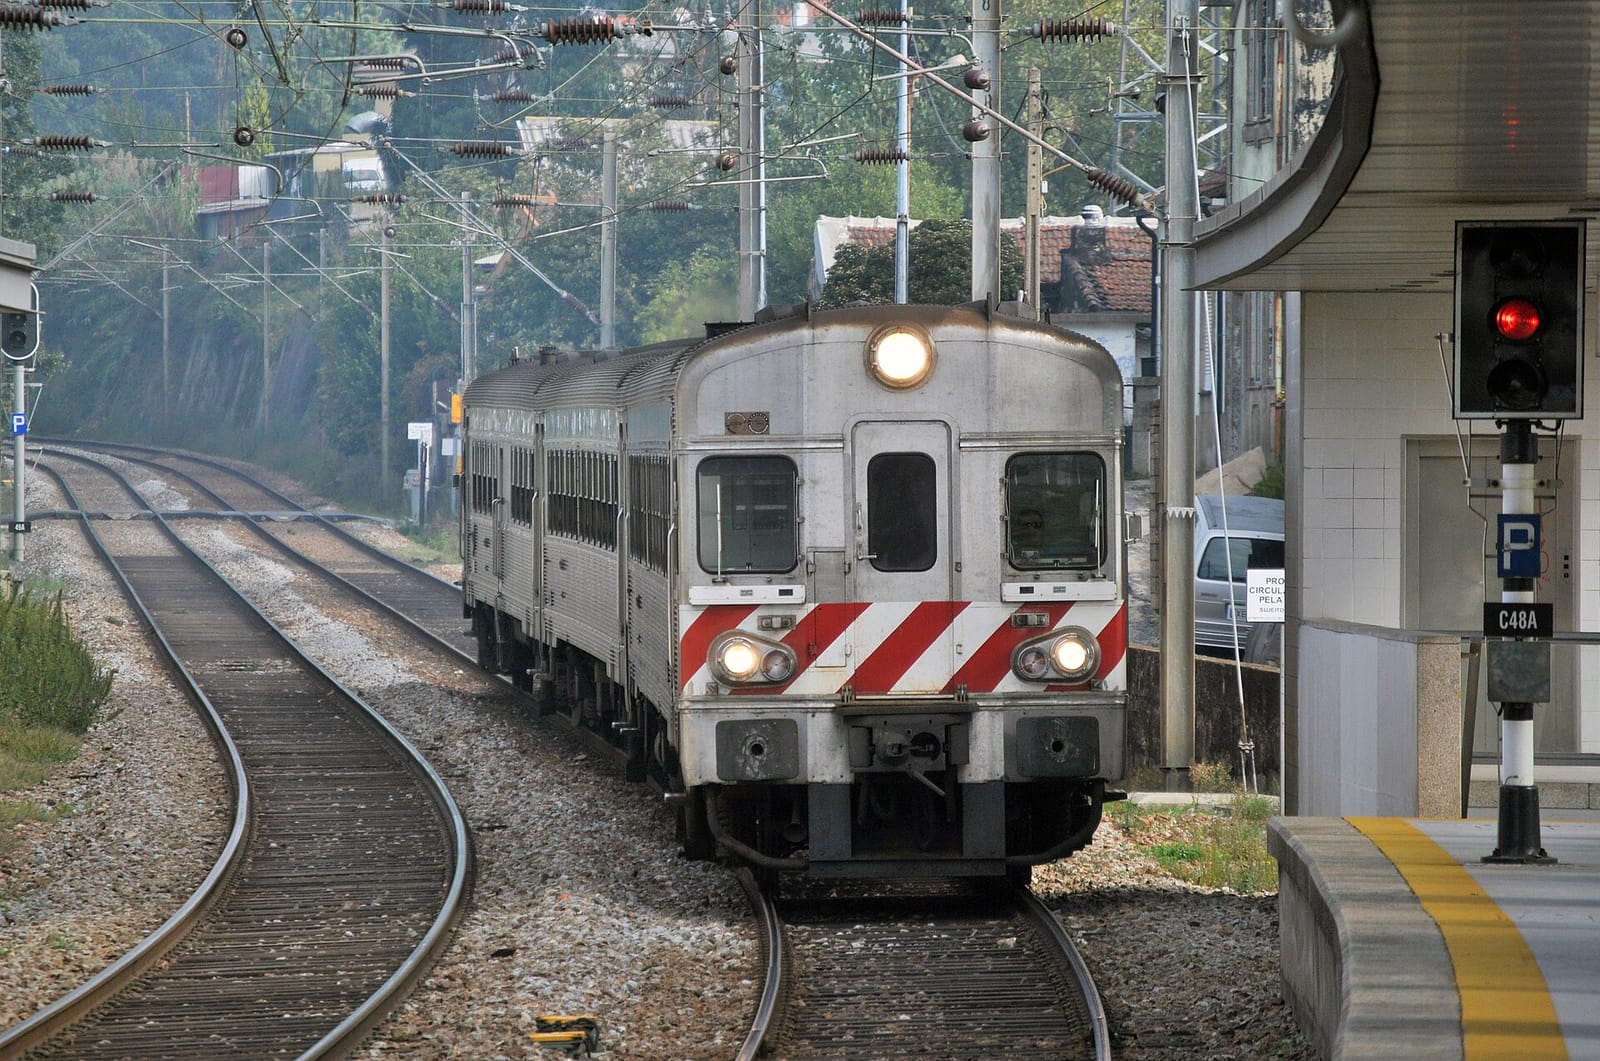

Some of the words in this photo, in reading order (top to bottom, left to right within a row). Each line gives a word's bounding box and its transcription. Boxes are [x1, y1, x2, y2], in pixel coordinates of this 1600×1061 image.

[13, 415, 25, 433] P
[1503, 522, 1535, 570] P
[1249, 586, 1285, 594] CIRCUL
[1259, 596, 1283, 604] PELA
[1499, 610, 1538, 630] C48A
